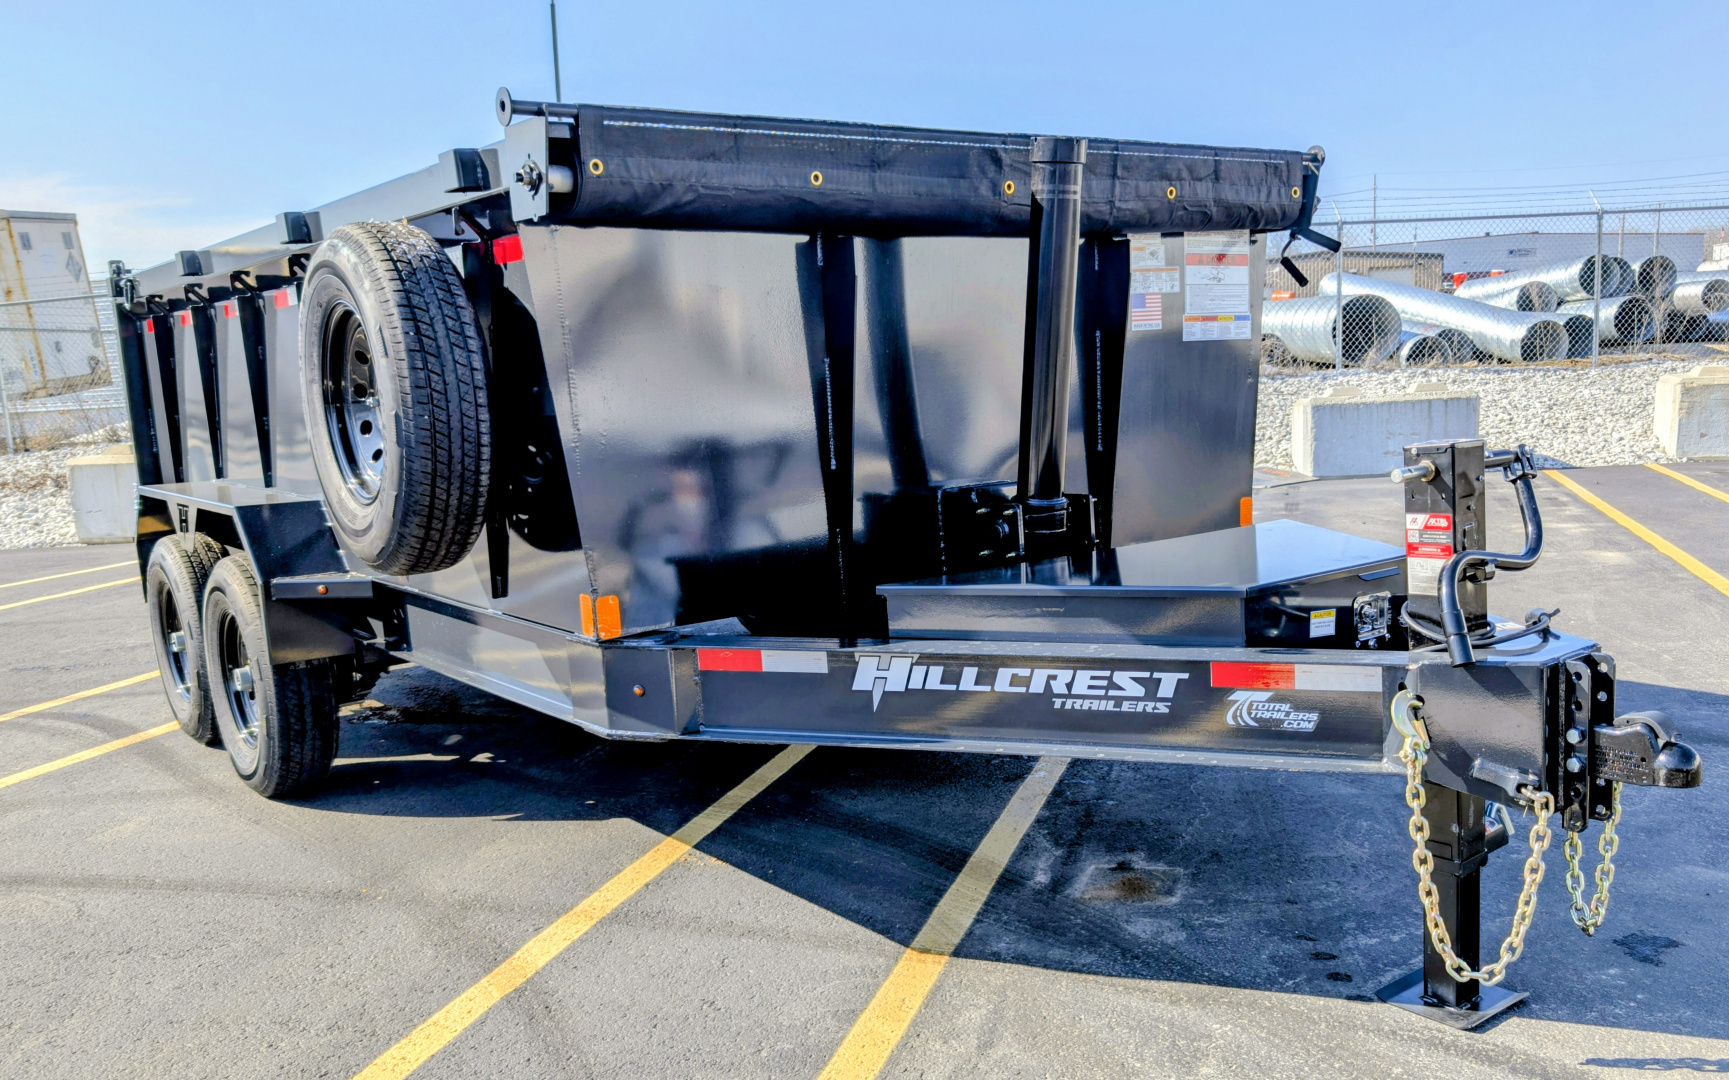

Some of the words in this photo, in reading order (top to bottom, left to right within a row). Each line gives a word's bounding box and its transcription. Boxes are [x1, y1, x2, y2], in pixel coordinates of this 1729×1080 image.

[852, 653, 1189, 712] HILLCREST
[1052, 698, 1171, 713] TRAILERS
[1251, 701, 1294, 712] TOTAL
[1250, 710, 1319, 721] TRAILERS
[1280, 719, 1315, 729] .COM
